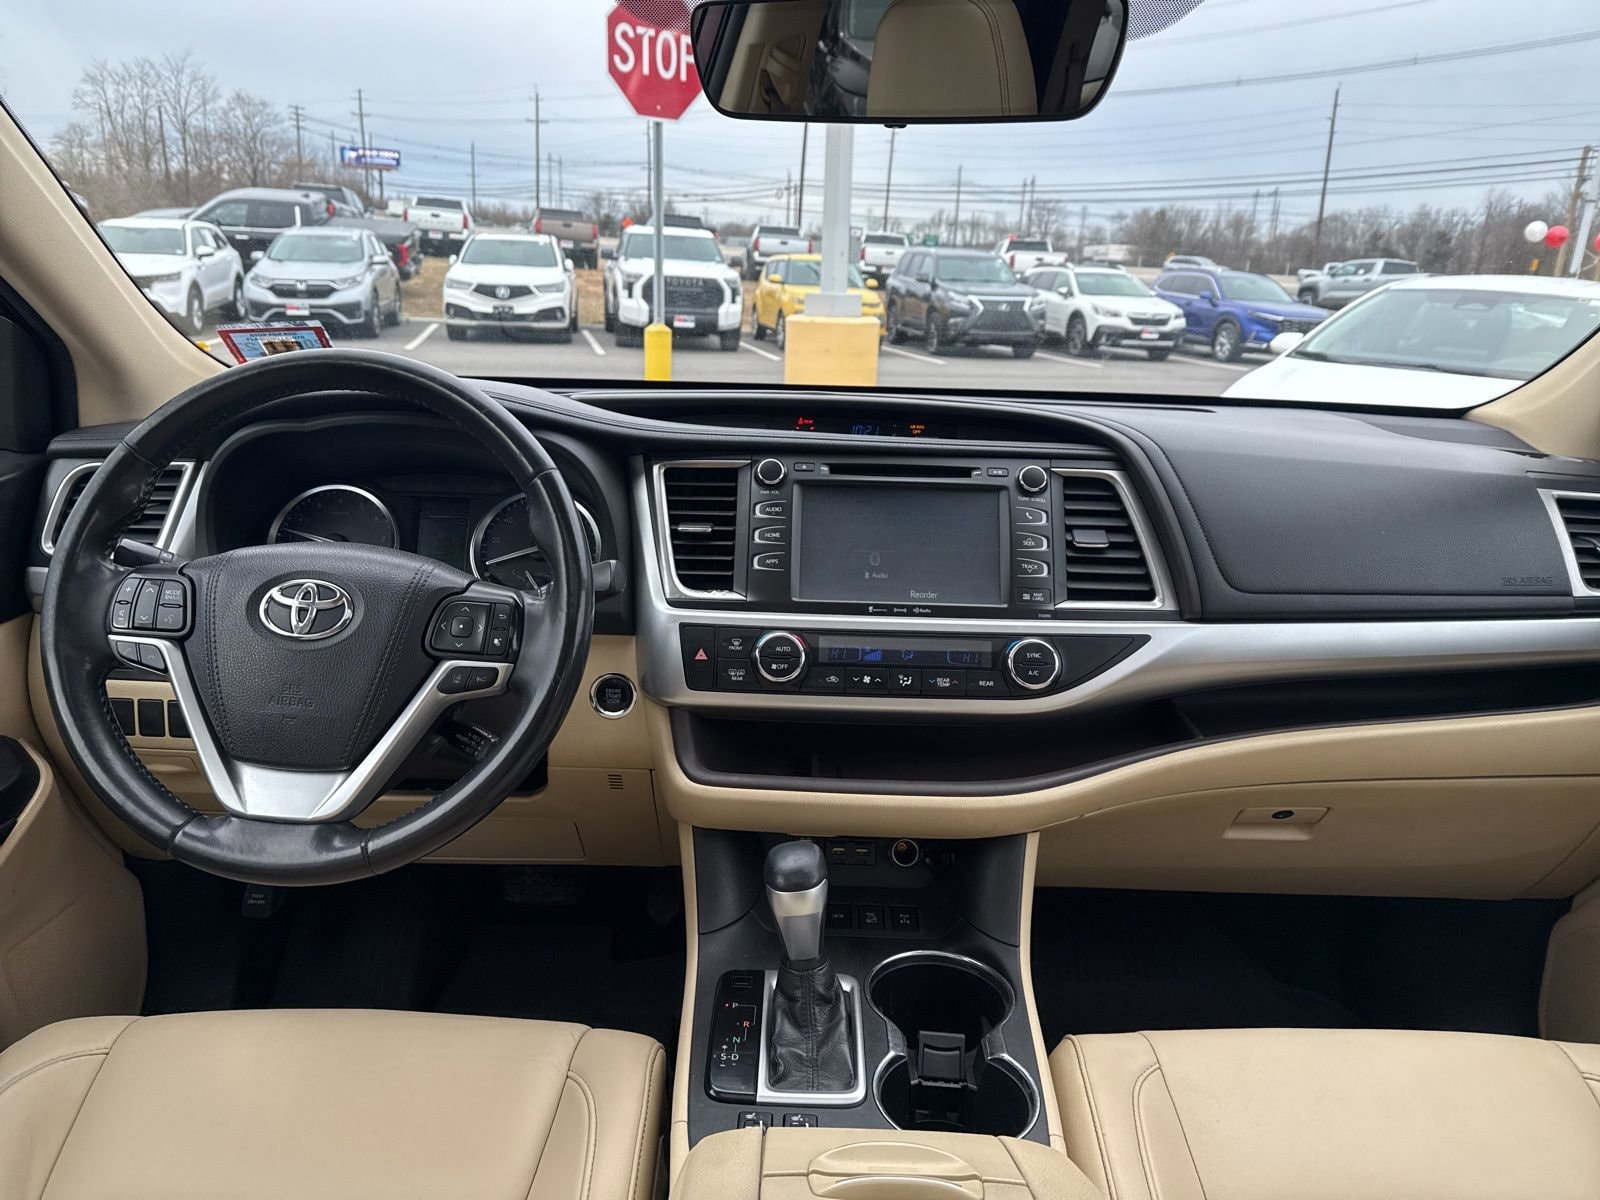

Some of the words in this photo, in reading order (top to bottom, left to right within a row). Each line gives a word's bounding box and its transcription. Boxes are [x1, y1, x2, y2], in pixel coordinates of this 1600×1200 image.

[613, 21, 694, 82] STOP
[871, 571, 889, 579] Audio
[910, 590, 938, 599] Reorder
[743, 1020, 750, 1028] R
